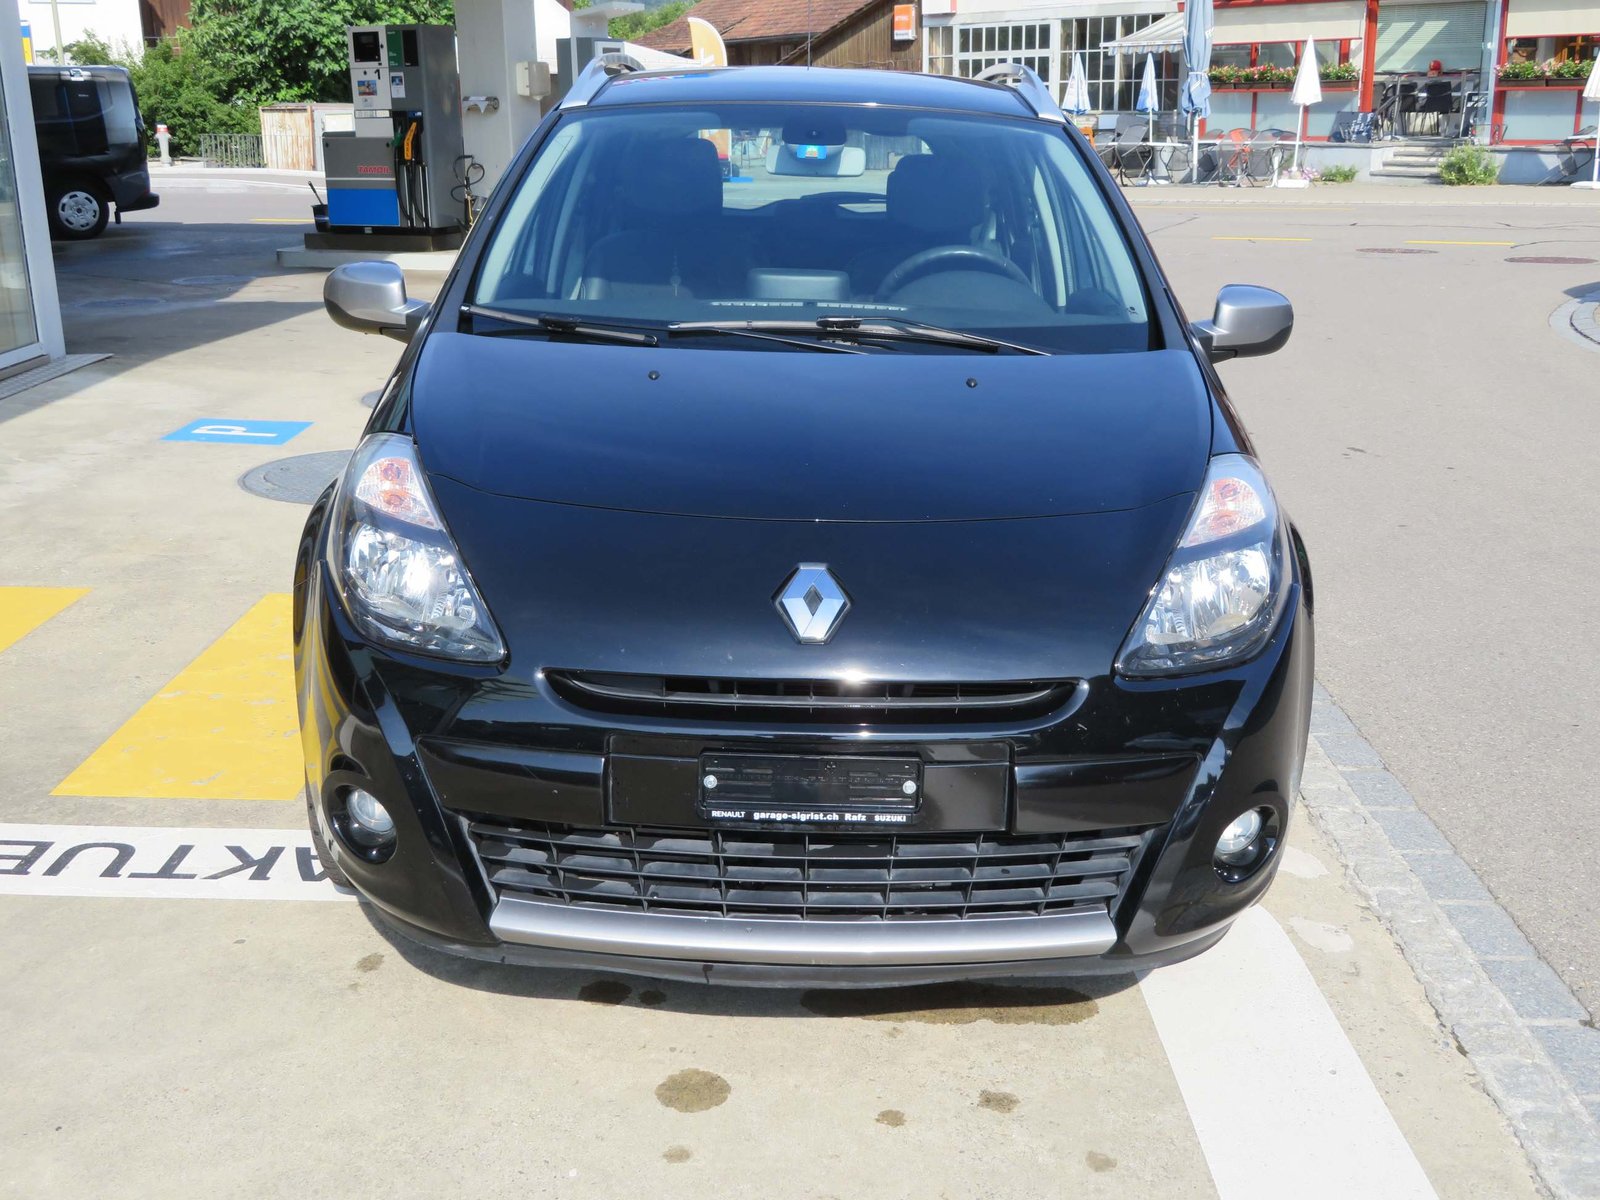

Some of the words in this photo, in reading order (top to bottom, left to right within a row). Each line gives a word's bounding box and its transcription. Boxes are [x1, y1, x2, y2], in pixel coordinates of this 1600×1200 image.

[374, 69, 381, 80] 1
[191, 425, 278, 437] P
[711, 810, 746, 818] RENAULT
[753, 811, 839, 821] garage-sigrist.ch
[844, 813, 867, 821] Rafz
[874, 814, 907, 822] SUZUKI
